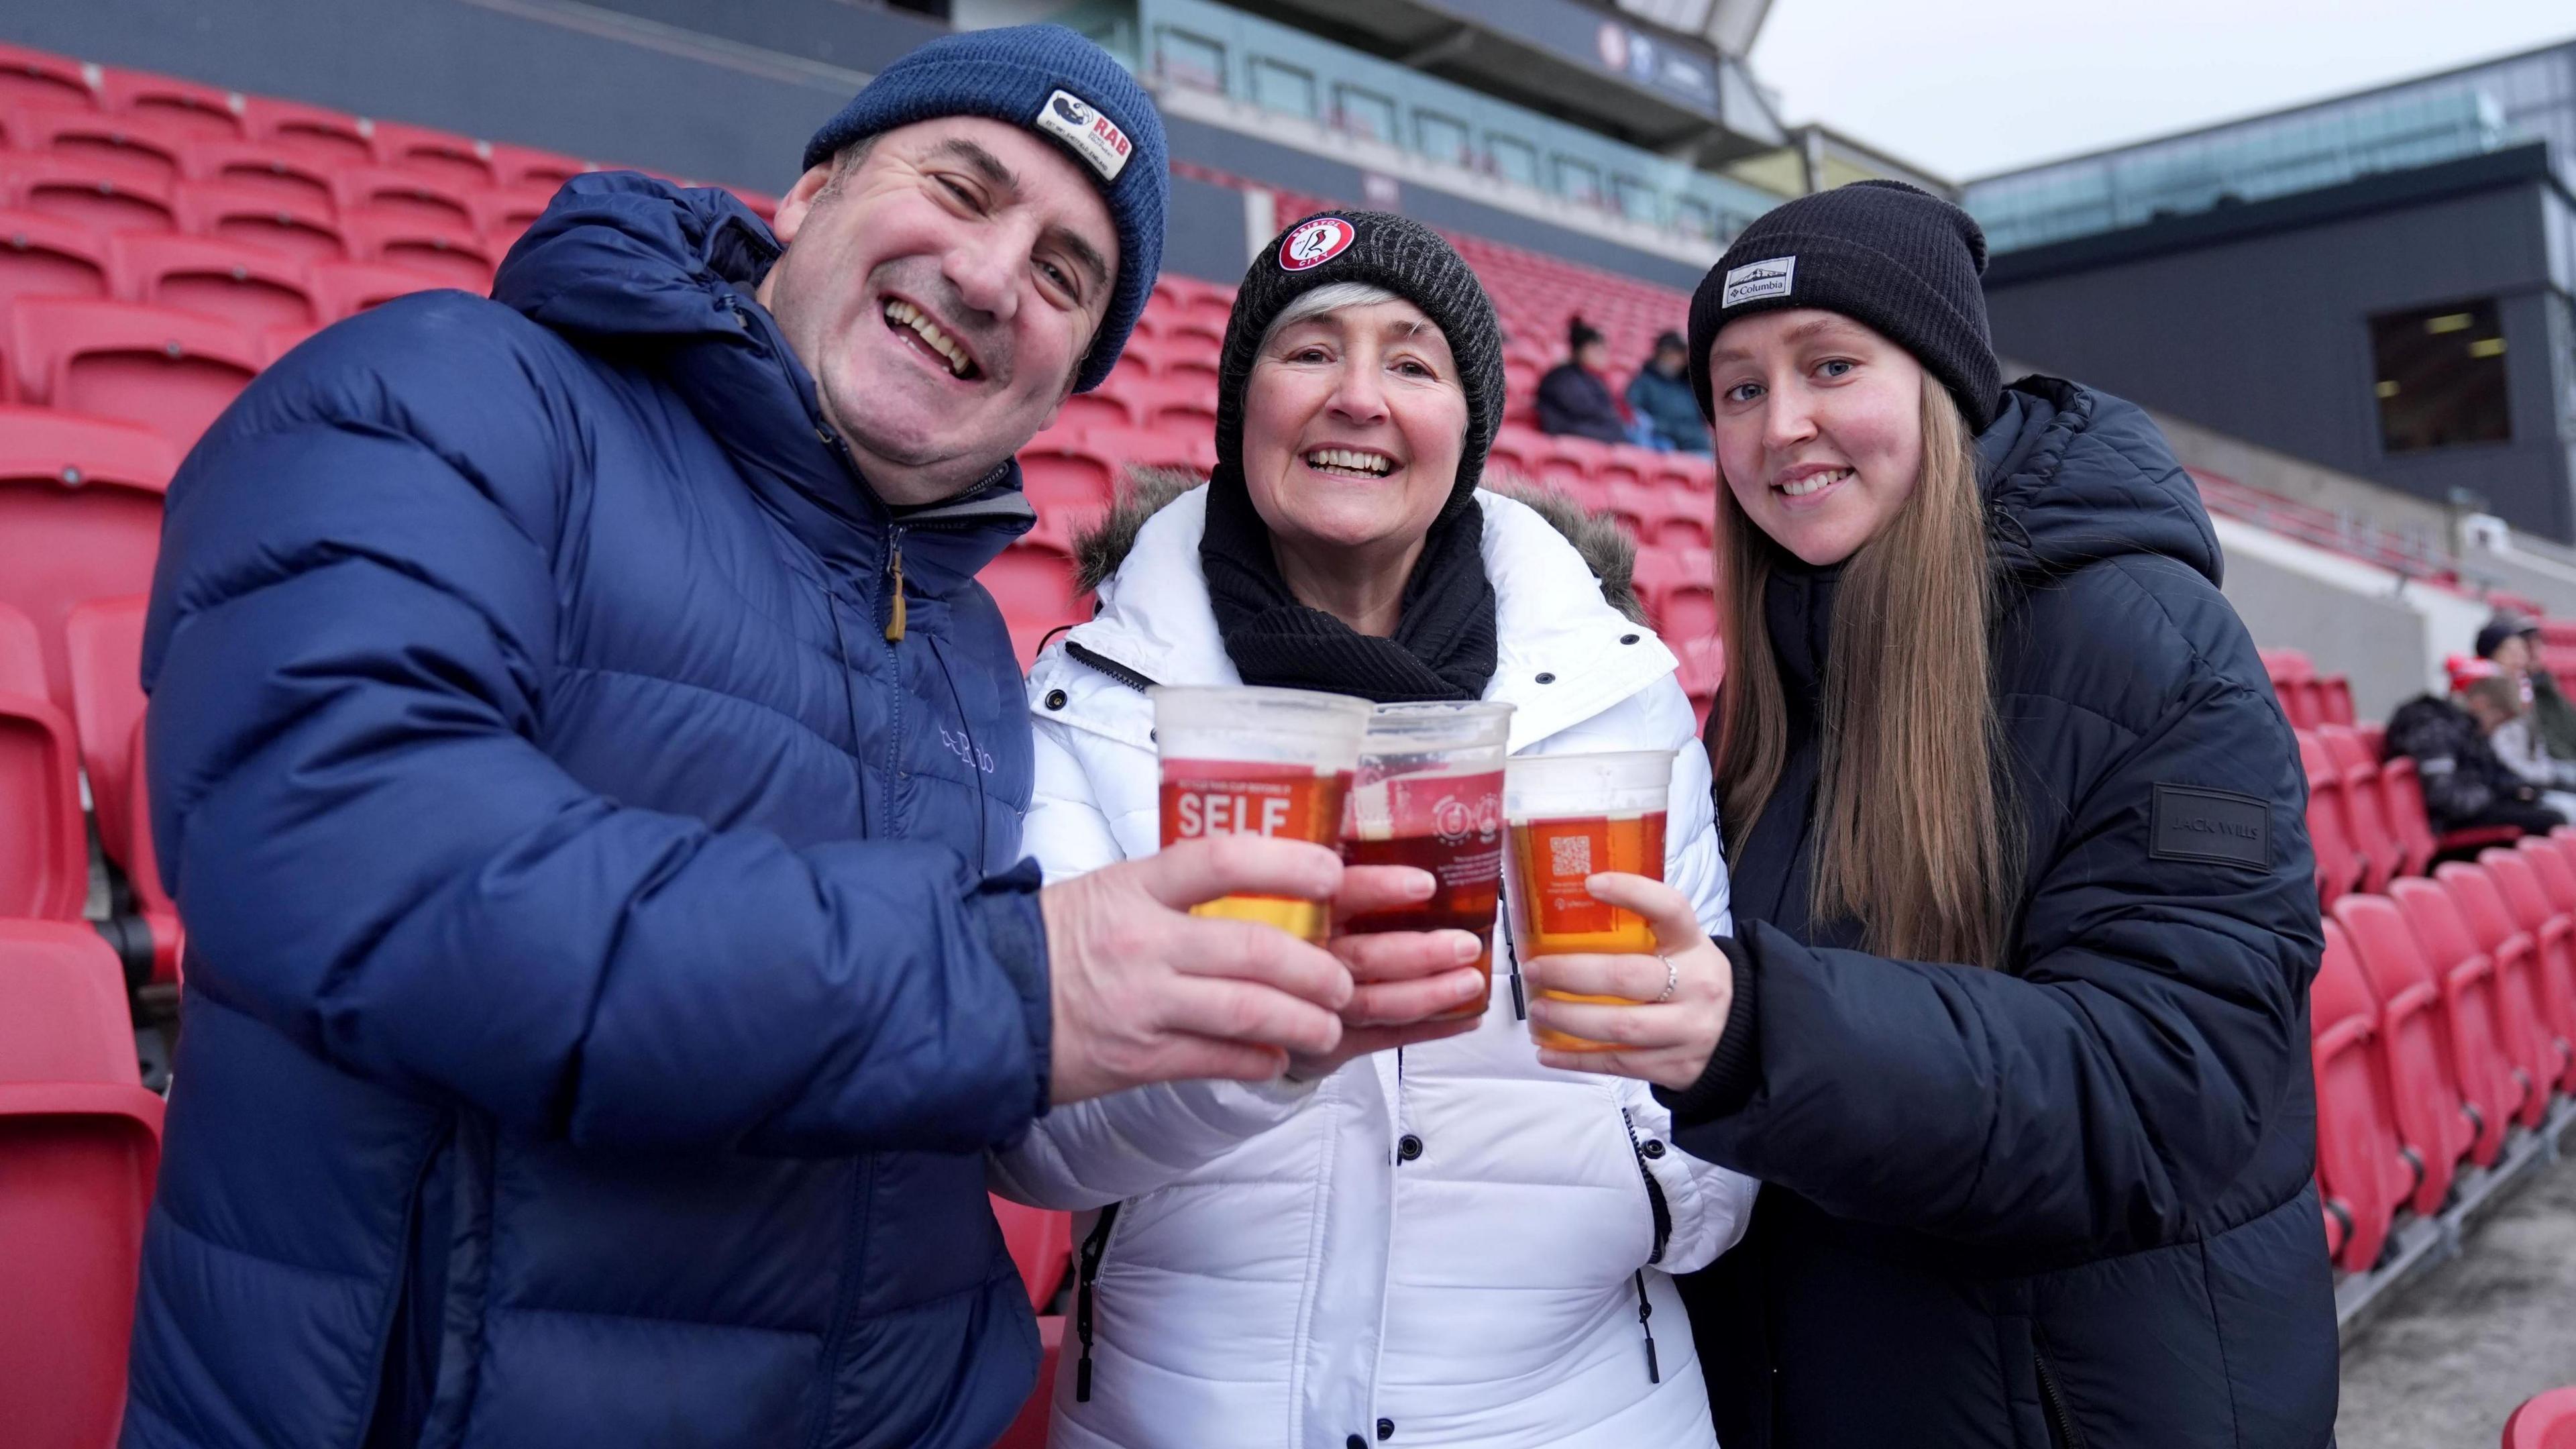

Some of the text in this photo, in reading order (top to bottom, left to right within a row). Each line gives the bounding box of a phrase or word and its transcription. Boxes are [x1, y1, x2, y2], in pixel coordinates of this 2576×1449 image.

[1094, 117, 1128, 156] RAB
[1089, 152, 1108, 171] ENGLAND
[1293, 221, 1340, 237] BRISTOL
[1299, 252, 1329, 267] CITY
[1740, 281, 1782, 294] Columbia
[1177, 792, 1291, 837] SELF
[2172, 817, 2259, 840] JACK WILLS
